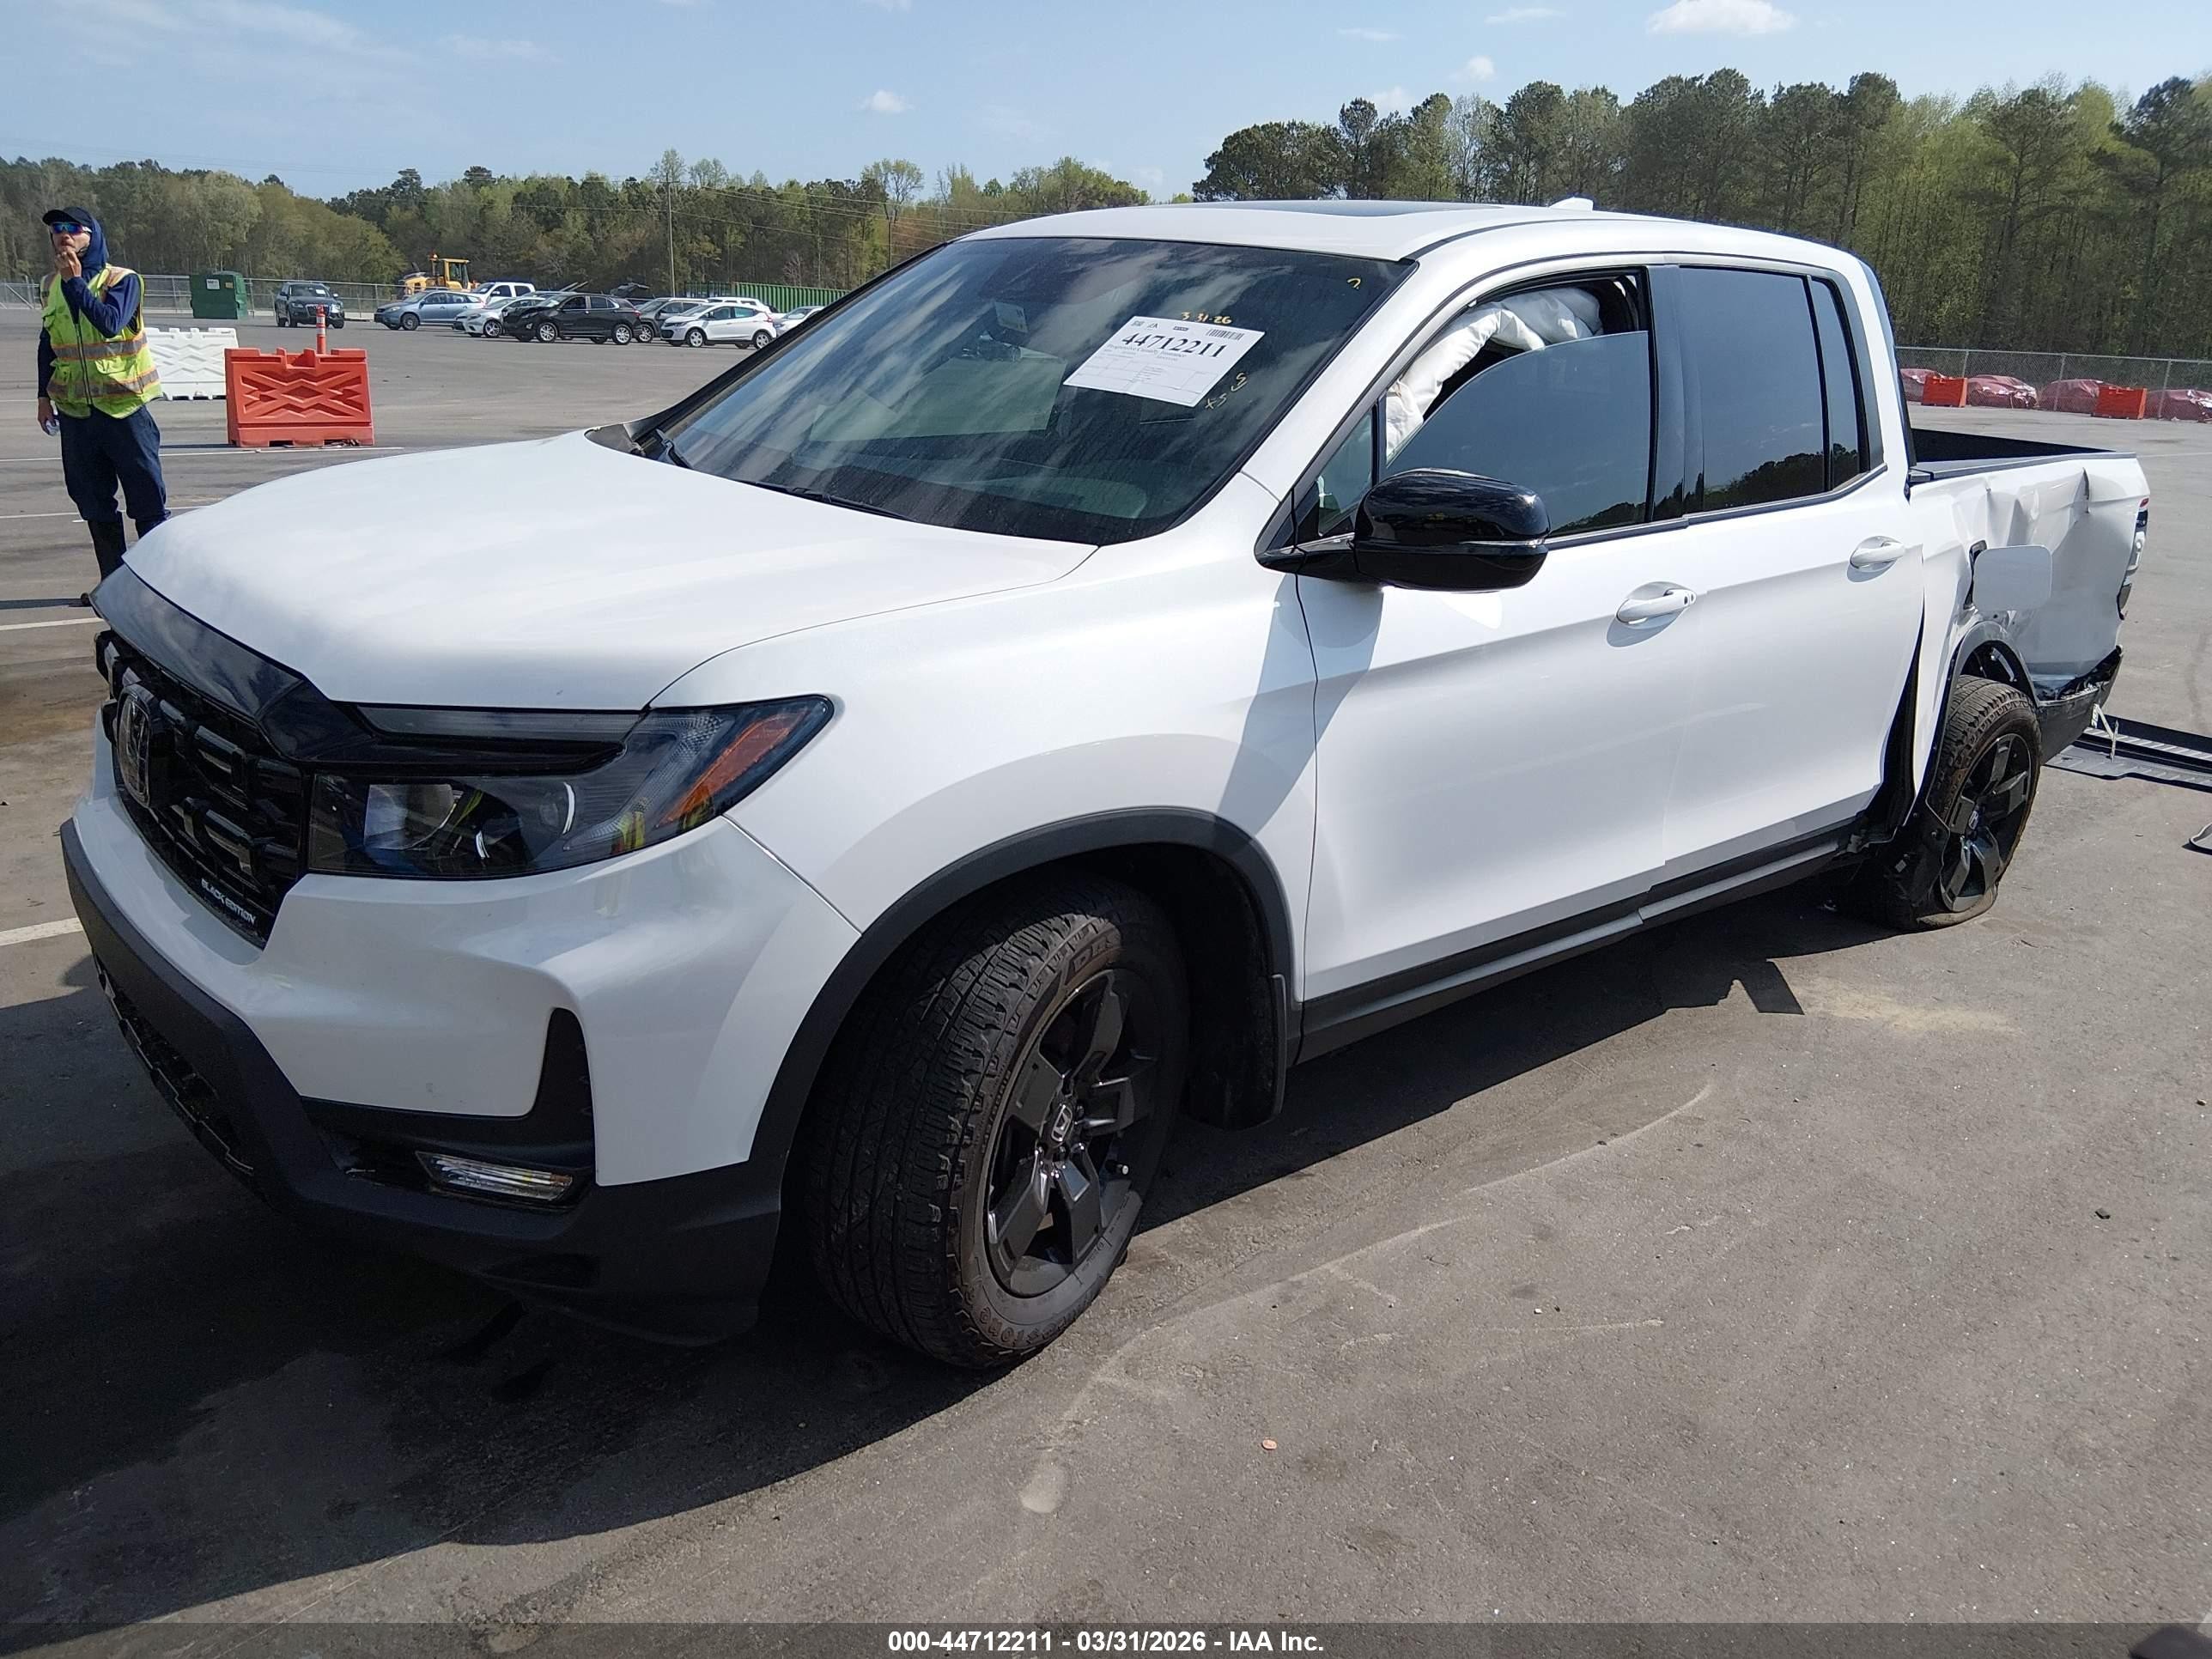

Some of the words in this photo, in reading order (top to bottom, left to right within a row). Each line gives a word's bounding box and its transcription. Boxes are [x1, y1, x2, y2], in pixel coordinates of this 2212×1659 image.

[1121, 332, 1227, 358] 44712211
[201, 877, 225, 905] BLACK
[224, 896, 257, 926] EDITION
